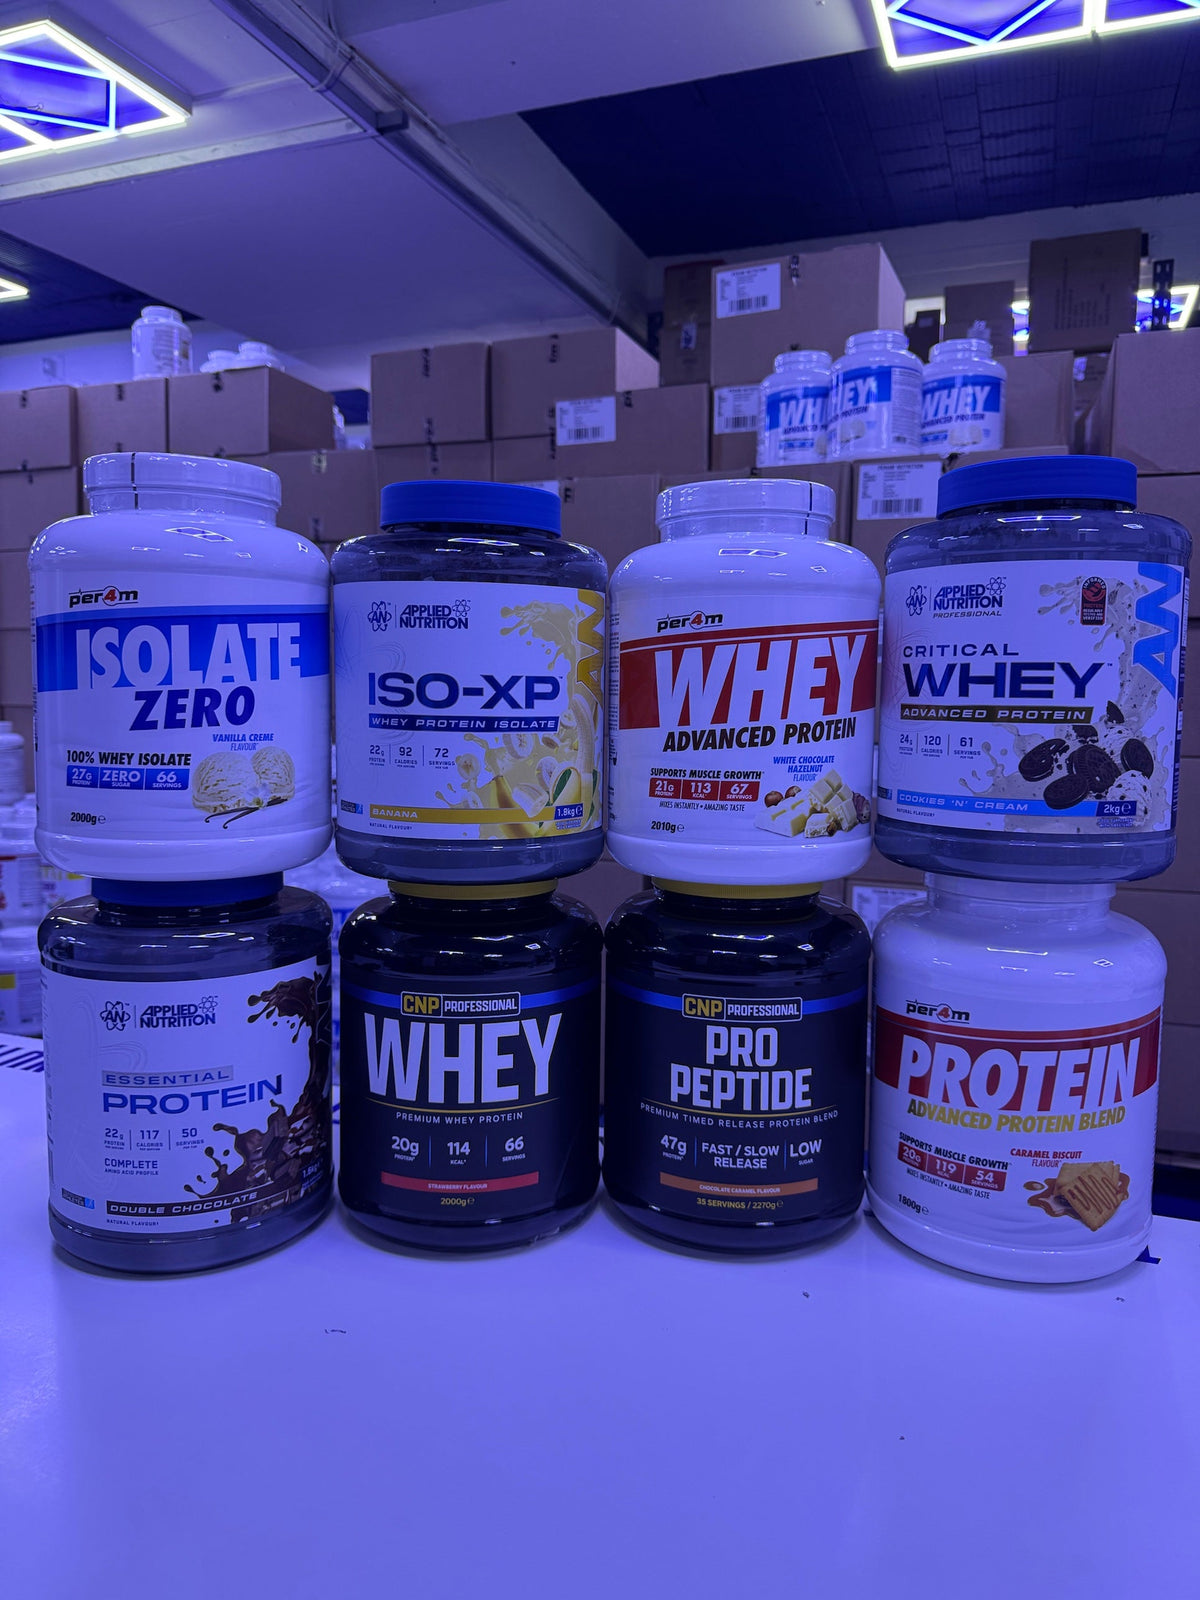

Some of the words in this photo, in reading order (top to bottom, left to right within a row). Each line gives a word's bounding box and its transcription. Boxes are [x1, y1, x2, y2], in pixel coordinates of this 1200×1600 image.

[780, 398, 827, 430] WH
[68, 587, 139, 608] per4m
[935, 584, 986, 597] APPLIED
[401, 605, 452, 617] APPLIED
[933, 595, 1003, 611] NUTRITION
[656, 611, 724, 633] per4m
[933, 610, 1003, 618] PROFESSIONAL
[400, 616, 469, 630] NUTRITION
[76, 622, 301, 690] ISOLATE
[902, 643, 1019, 658] CRITICAL
[654, 634, 867, 727] WHEY
[902, 662, 1106, 699] WHEY
[368, 672, 561, 710] ISO-XP
[129, 685, 255, 732] ZERO
[902, 707, 988, 719] ADVANCED
[997, 709, 1087, 720] PROTEIN
[372, 717, 409, 726] WHEY
[415, 719, 486, 729] PROTEIN
[494, 720, 556, 729] ISOLATE
[212, 733, 246, 743] VANILLA
[248, 732, 275, 742] CREME
[662, 726, 776, 752] ADVANCED
[782, 717, 857, 745] PROTEIN
[923, 735, 942, 746] 120
[959, 736, 974, 748] 61
[66, 750, 95, 764] 100%
[98, 752, 135, 766] WHEY
[138, 752, 191, 766] ISOLATE
[399, 746, 412, 757] 92
[434, 747, 449, 758] 72
[773, 756, 797, 765] WHITE
[798, 755, 835, 764] CHOCOLATE
[102, 769, 141, 783] ZERO
[156, 771, 177, 782] 66
[650, 768, 687, 778] SUPPORTS
[688, 769, 721, 779] MUSCLE
[787, 764, 824, 773] HAZELNUT
[690, 782, 712, 794] 113
[731, 783, 750, 795] 67
[673, 801, 700, 809] INSTANTLY
[703, 803, 729, 811] AMAZING
[729, 804, 745, 812] TASTE
[899, 793, 945, 806] COOKIES
[974, 801, 1029, 811] CREAM
[1103, 804, 1120, 815] 2kg
[372, 808, 418, 818] BANANA
[140, 1004, 198, 1018] APPLIED
[403, 994, 440, 1015] CNP
[444, 998, 518, 1013] PROFESSIONAL
[684, 996, 723, 1017] CNP
[727, 1003, 800, 1017] PROFESSIONAL
[139, 1013, 216, 1029] NUTRITION
[705, 1024, 778, 1067] PRO
[364, 1012, 563, 1104] WHEY
[105, 1070, 230, 1086] ESSENTIAL
[898, 1034, 1141, 1112] PROTEIN
[102, 1074, 283, 1115] PROTEIN
[670, 1062, 813, 1111] PEPTIDE
[396, 1111, 441, 1124] PREMIUM
[445, 1116, 475, 1124] WHEY
[479, 1112, 523, 1124] PROTEIN
[640, 1103, 679, 1120] PREMIUM
[683, 1114, 714, 1126] TIMED
[718, 1119, 765, 1129] RELEASE
[769, 1114, 810, 1128] PROTEIN
[813, 1110, 838, 1123] BLEND
[907, 1098, 992, 1130] ADVANCED
[996, 1113, 1075, 1133] PROTEIN
[1078, 1105, 1126, 1131] BLEND
[140, 1129, 160, 1140] 117
[181, 1127, 198, 1138] 50
[391, 1135, 419, 1156] 20g
[447, 1141, 471, 1156] 114
[504, 1135, 524, 1152] 66
[660, 1134, 687, 1156] 47g
[701, 1142, 733, 1156] FAST
[744, 1145, 780, 1157] SLOW
[789, 1139, 823, 1157] LOW
[899, 1131, 933, 1153] SUPPORTS
[934, 1147, 966, 1163] MUSCLE
[502, 1153, 526, 1162] SERVINGS
[1010, 1148, 1050, 1159] CARAMEL
[1052, 1150, 1083, 1160] BISCUIT
[104, 1157, 158, 1169] COMPLETE
[713, 1156, 768, 1169] RELEASE
[935, 1158, 957, 1175] 119
[975, 1170, 994, 1183] 54
[699, 1184, 731, 1193] CHOCOLATE
[731, 1186, 756, 1194] CARAMEL
[919, 1172, 945, 1188] INSTANTLY
[948, 1183, 973, 1196] AMAZING
[973, 1189, 990, 1200] TASTE
[970, 1180, 999, 1190] SERVINGS
[110, 1203, 165, 1214] DOUBLE
[172, 1191, 258, 1214] CHOCOLATE
[696, 1197, 706, 1206] 35
[707, 1199, 746, 1209] SERVINGS
